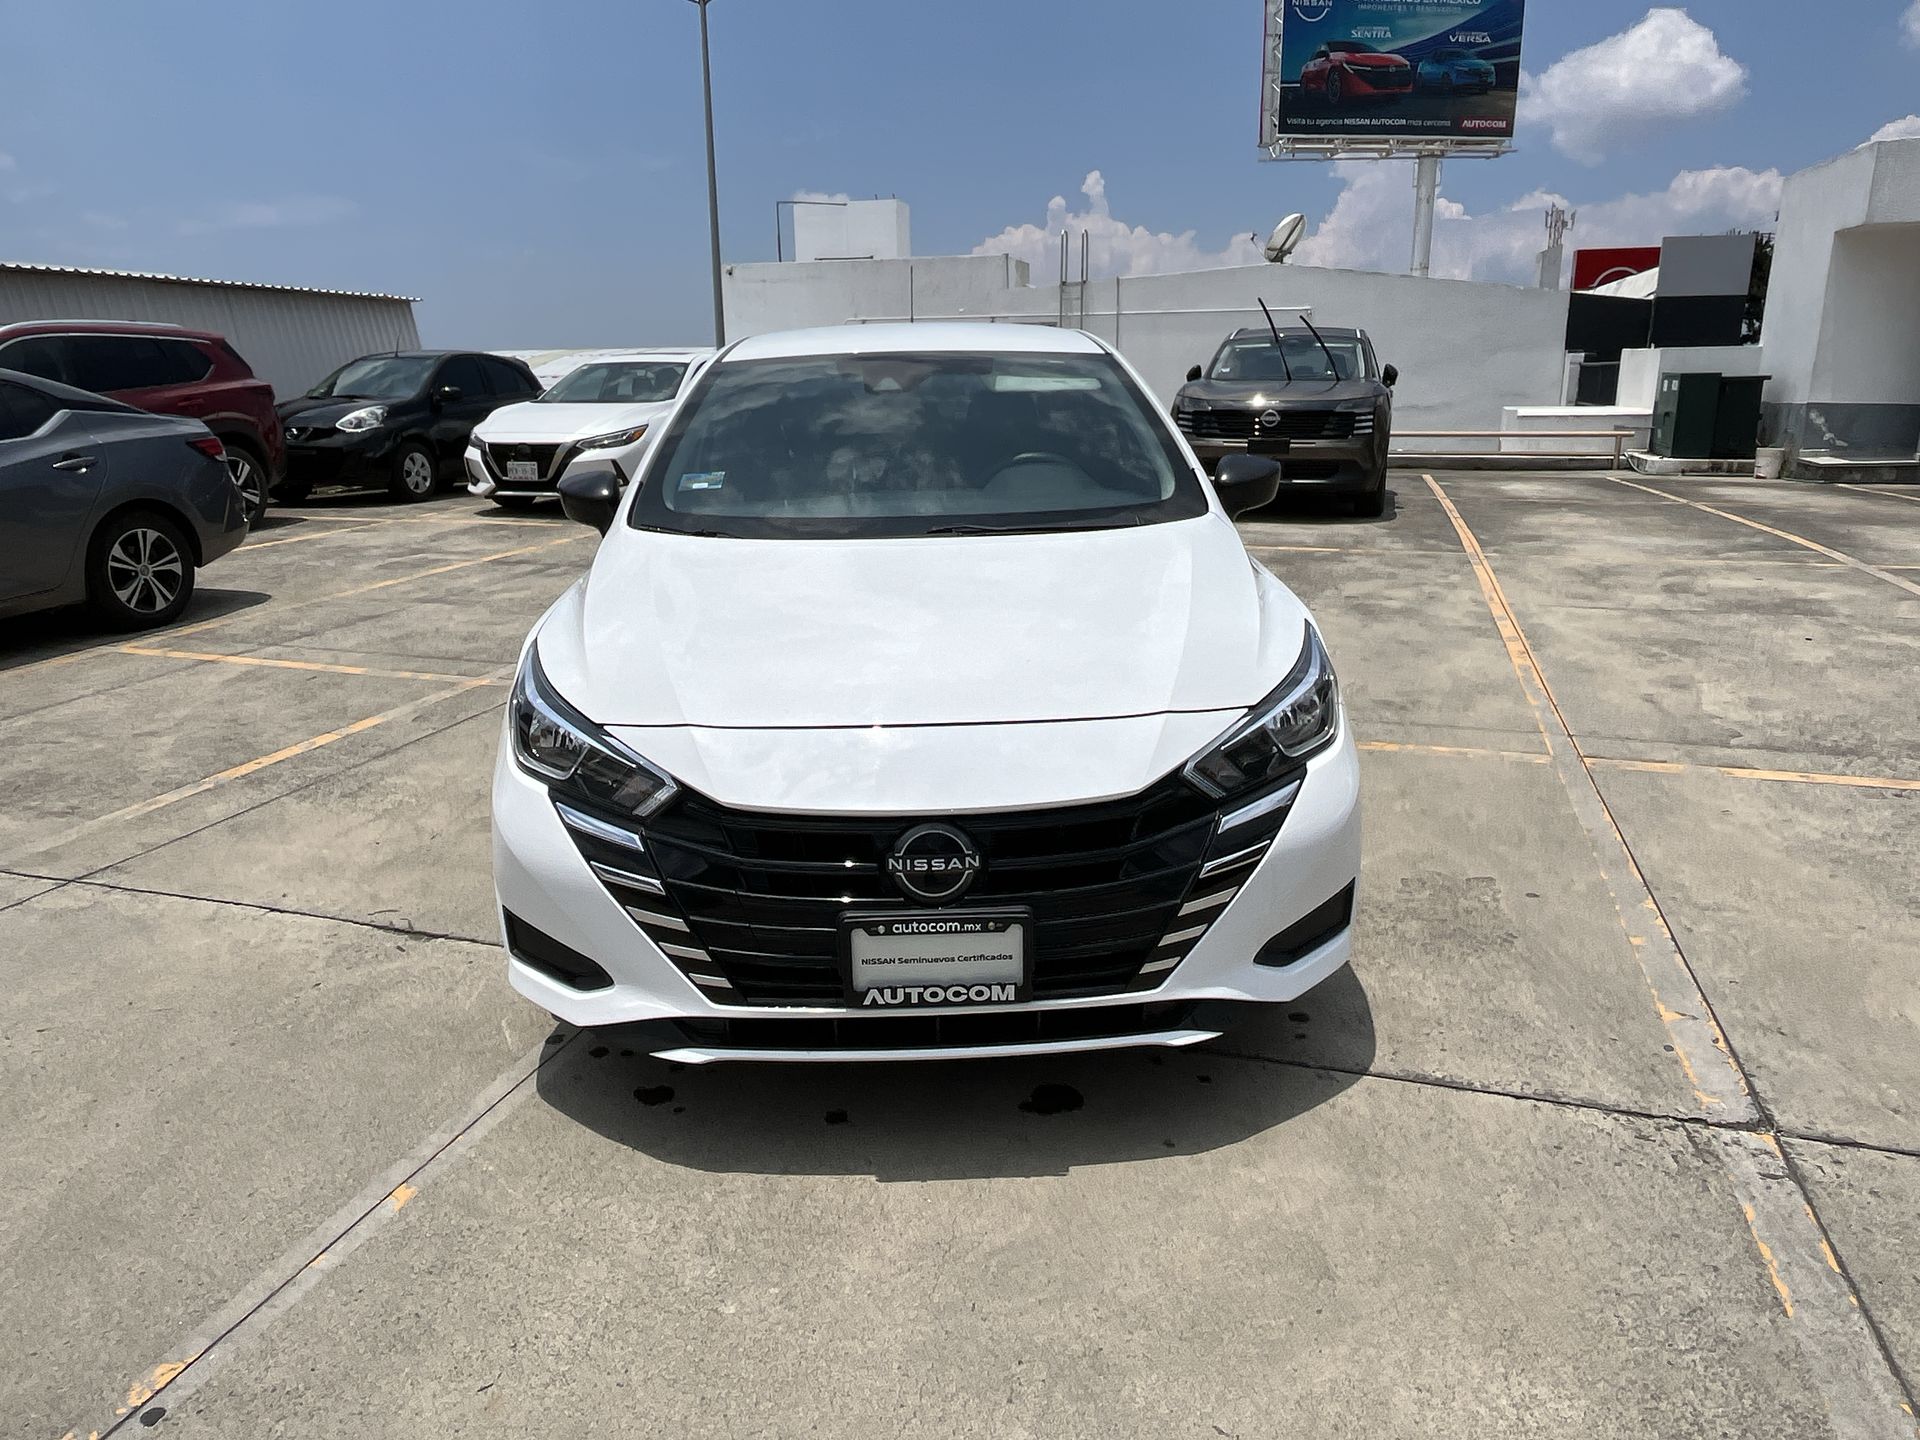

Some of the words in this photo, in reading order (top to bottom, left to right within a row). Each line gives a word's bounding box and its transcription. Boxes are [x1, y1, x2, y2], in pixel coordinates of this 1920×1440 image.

[1351, 30, 1392, 38] SENTRA
[1449, 35, 1491, 43] VERSA
[1462, 120, 1506, 128] AUTOCOM
[888, 855, 980, 871] NISSAN
[892, 921, 981, 933] autocom.mx
[861, 957, 895, 965] NISSAN
[897, 955, 955, 964] Seminuevos
[957, 953, 1013, 962] Certificados
[863, 984, 1016, 1005] AUTOCOM
